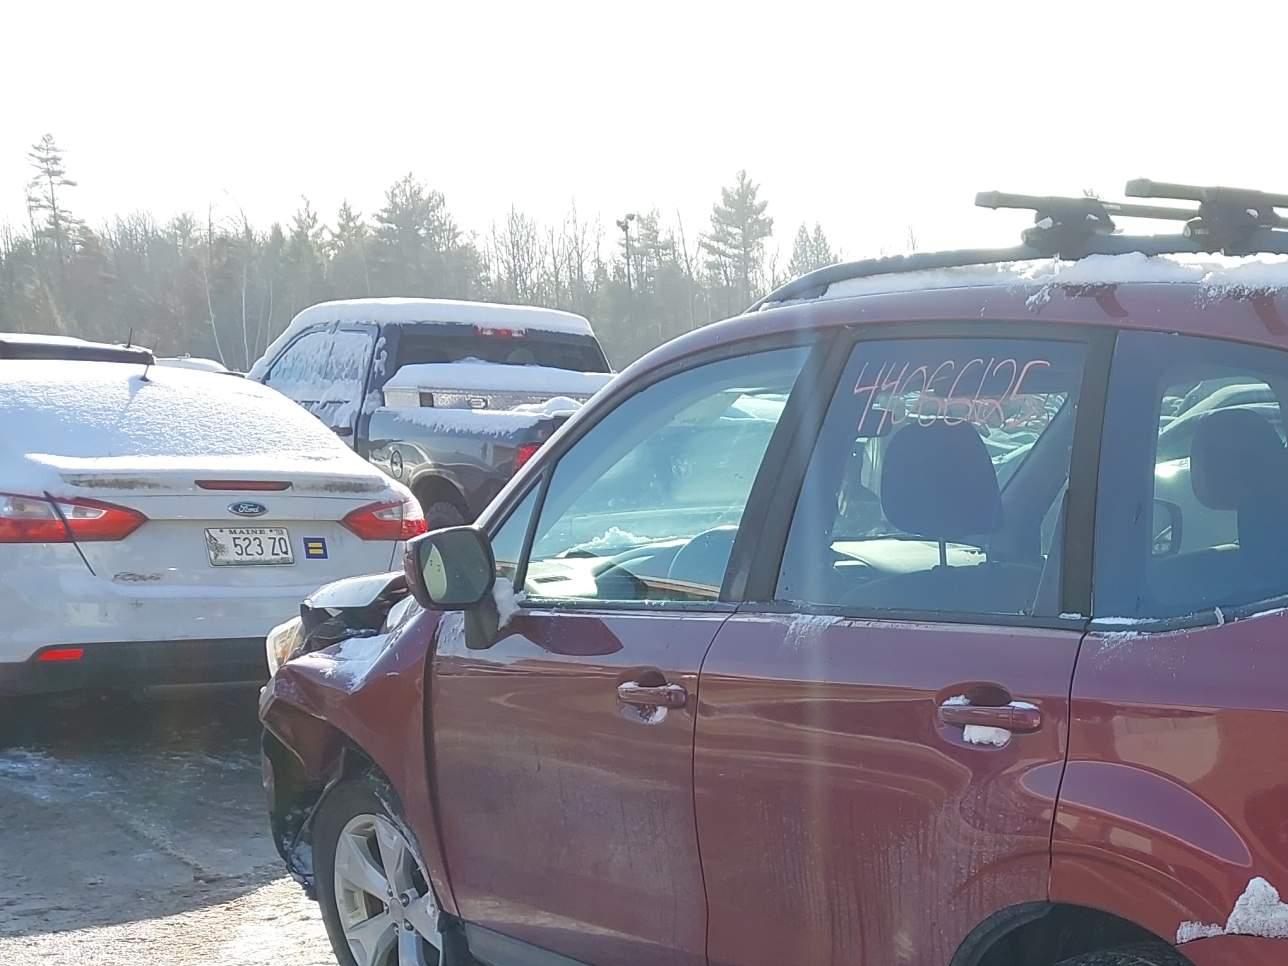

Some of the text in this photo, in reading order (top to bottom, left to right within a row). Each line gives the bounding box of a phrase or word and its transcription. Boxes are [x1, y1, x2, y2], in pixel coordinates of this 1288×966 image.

[853, 357, 1051, 436] 44066125
[238, 503, 260, 513] Ford
[232, 537, 289, 556] 523 ZQ
